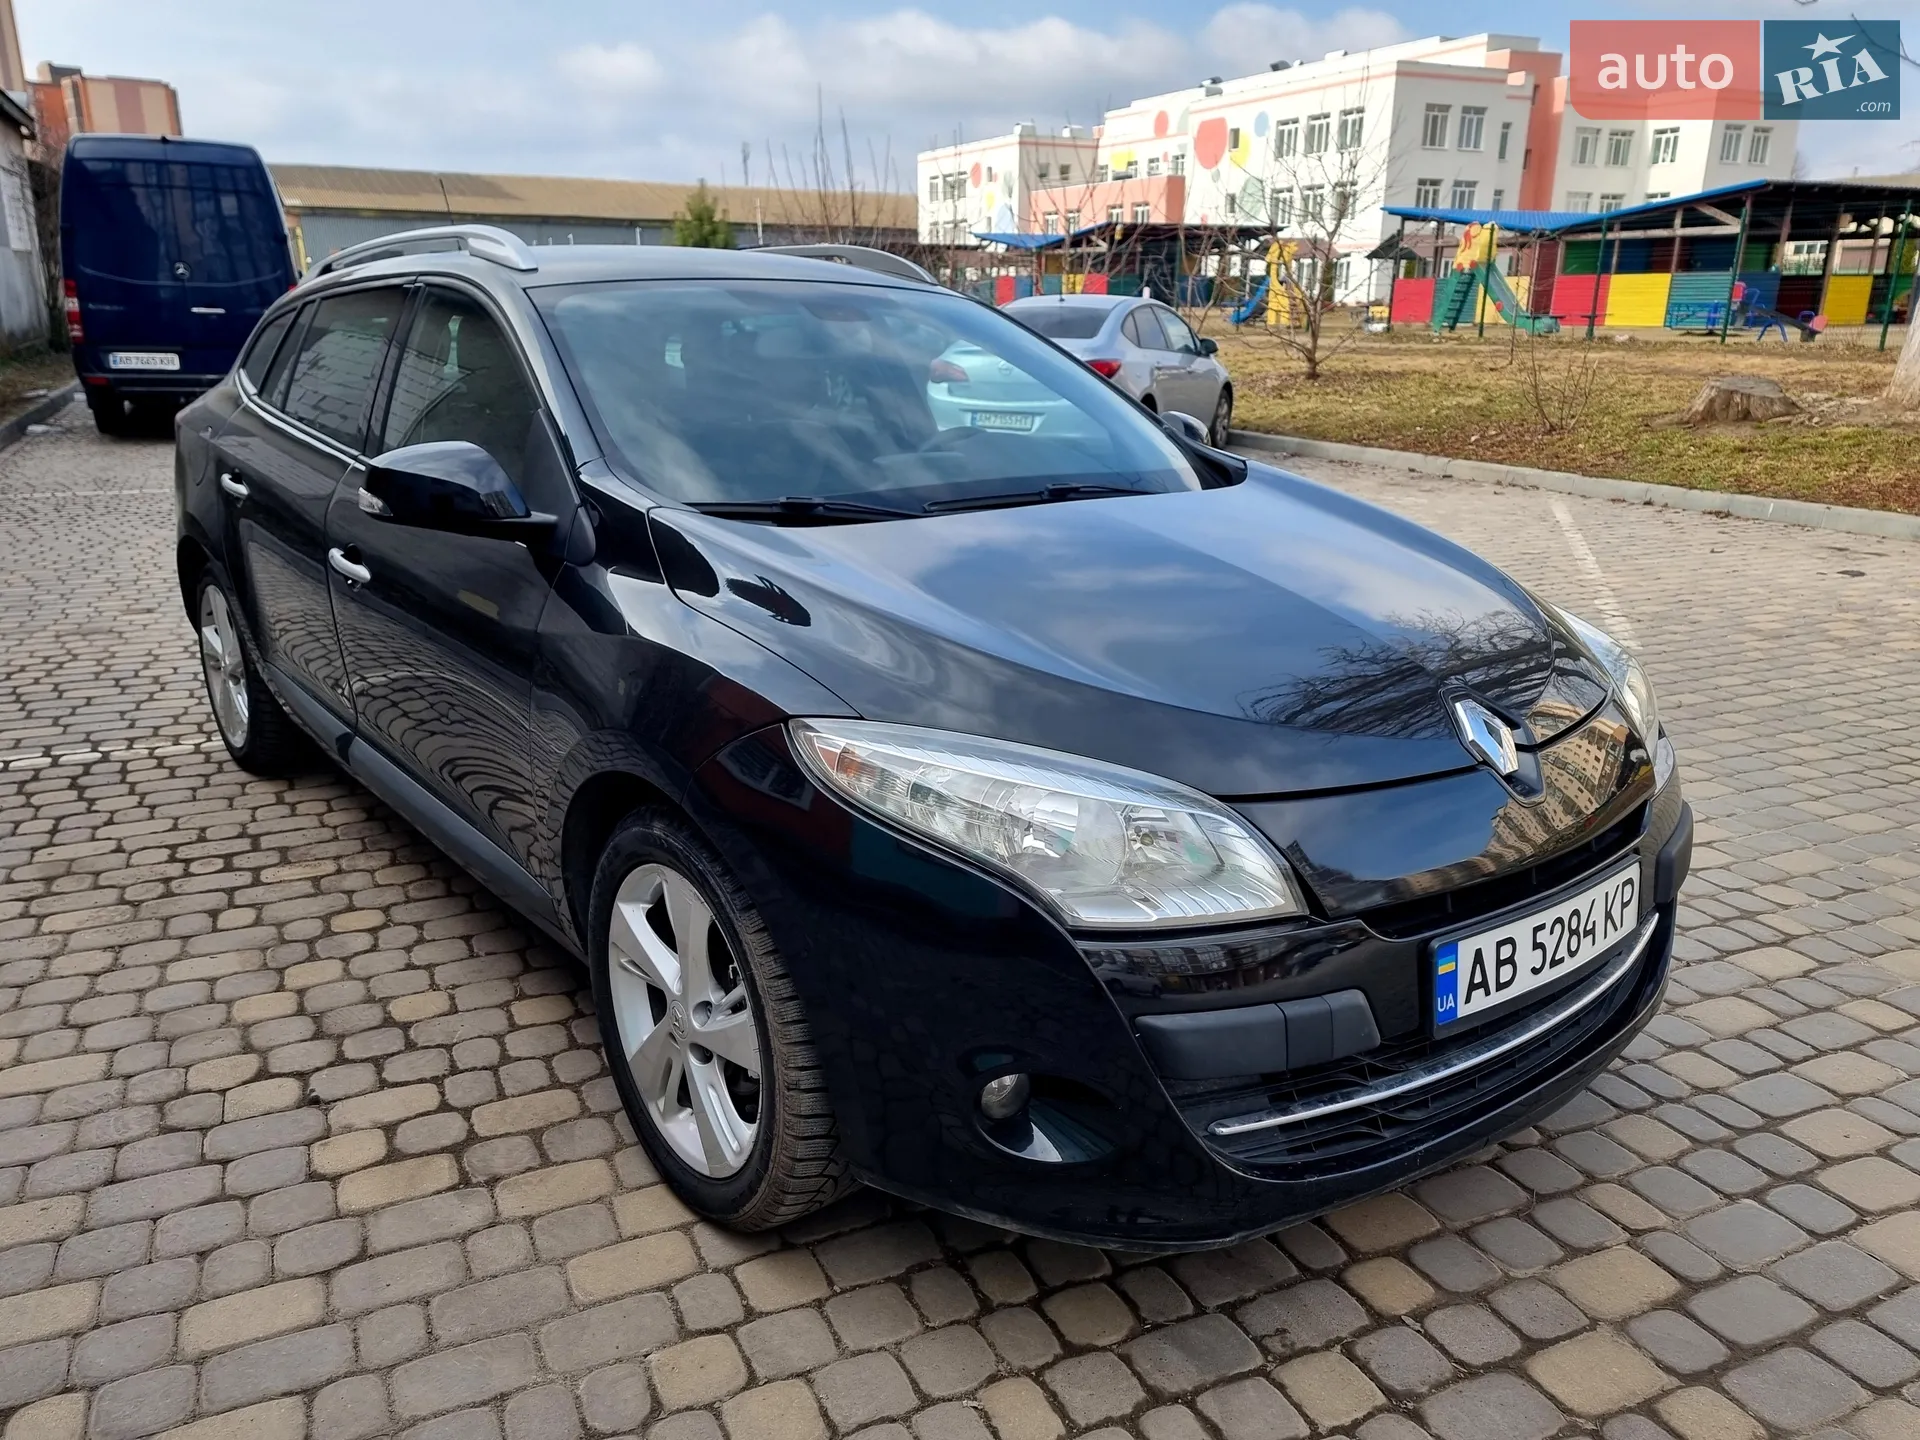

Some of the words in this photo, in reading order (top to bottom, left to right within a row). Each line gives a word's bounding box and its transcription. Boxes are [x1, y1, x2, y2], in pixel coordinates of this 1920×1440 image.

[1464, 936, 1518, 1005] AB
[1530, 898, 1597, 976] 5284
[1603, 876, 1635, 940] KP
[1437, 993, 1455, 1012] UA
